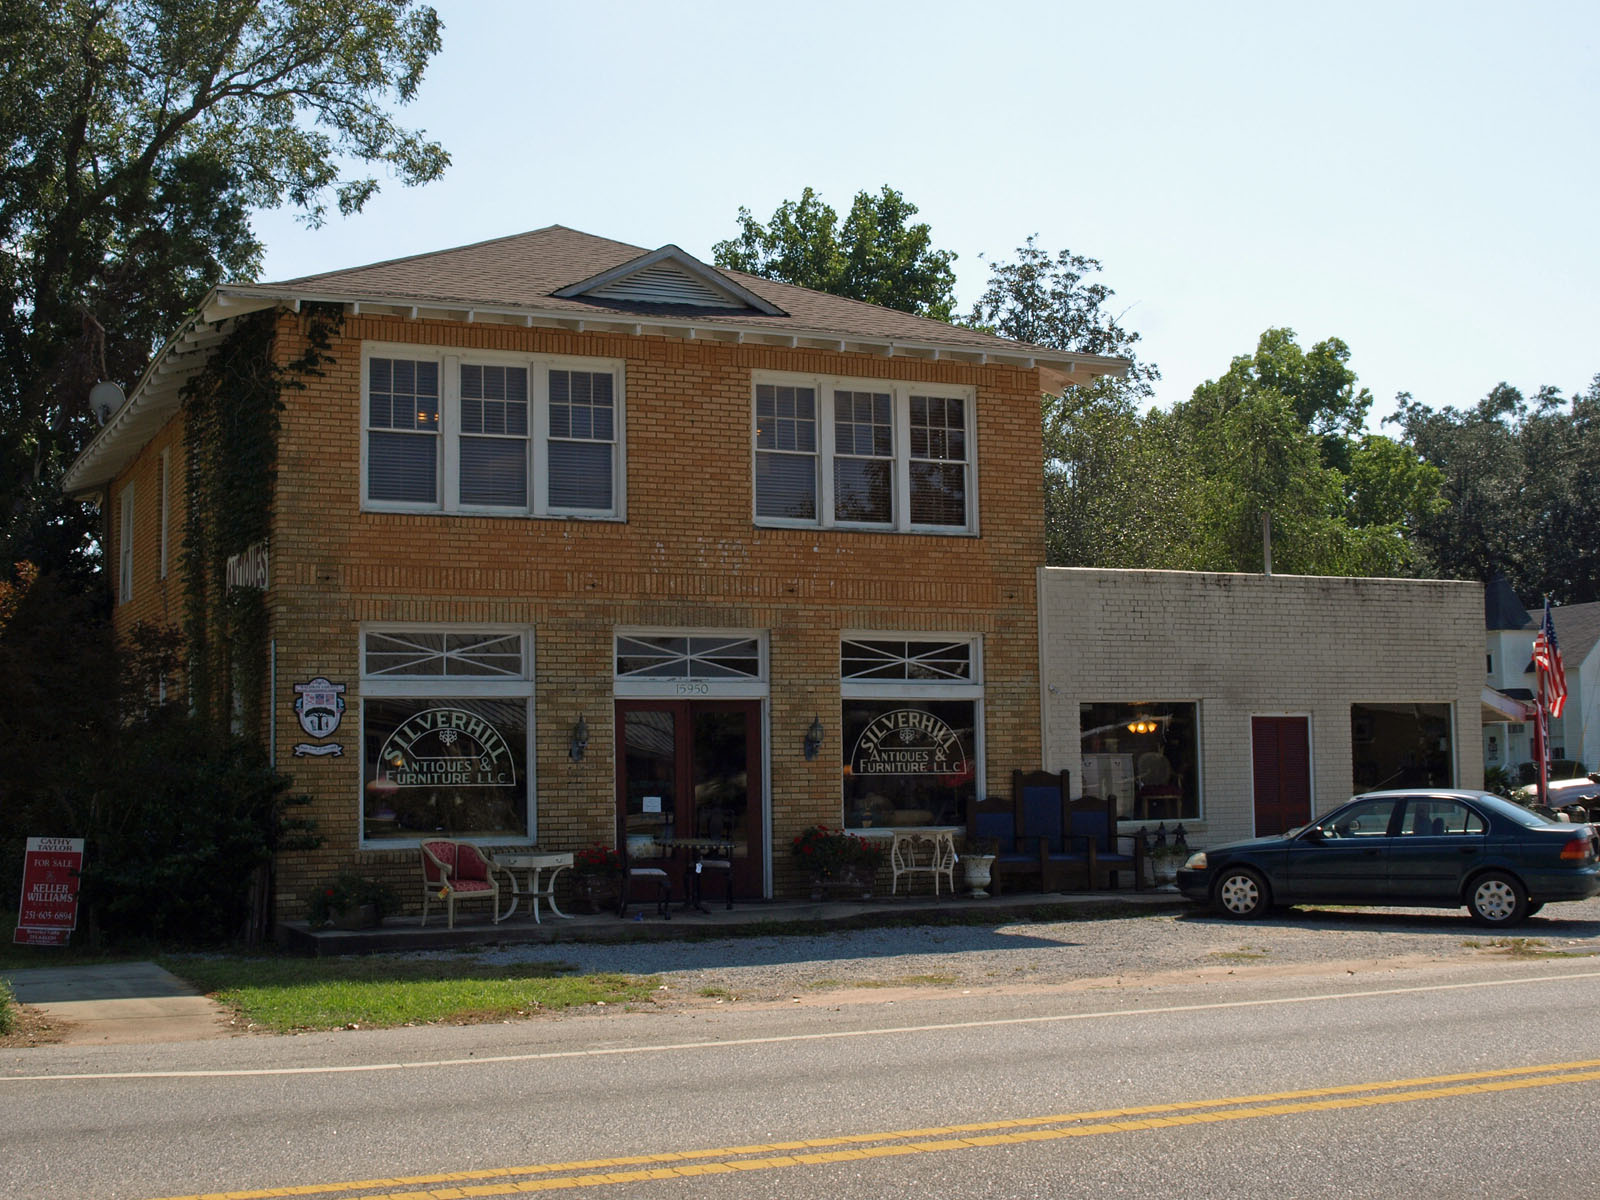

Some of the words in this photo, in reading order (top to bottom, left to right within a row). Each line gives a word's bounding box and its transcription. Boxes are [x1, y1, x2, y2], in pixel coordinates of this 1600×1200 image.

[676, 683, 709, 695] 15950
[383, 711, 507, 764] SILVERHILL
[861, 711, 956, 754] SILVERHILL
[870, 748, 929, 762] ANTIQUES
[935, 746, 946, 761] &
[397, 757, 472, 773] ANTIQUES
[480, 756, 492, 772] &
[860, 760, 928, 773] FURNITURE
[934, 762, 961, 773] LLC
[385, 770, 471, 784] FURNITURE
[477, 772, 506, 784] LLC
[34, 859, 50, 867] FOR
[52, 859, 72, 867] SALE
[33, 884, 69, 893] KELLER
[27, 892, 73, 903] WILLIAMS
